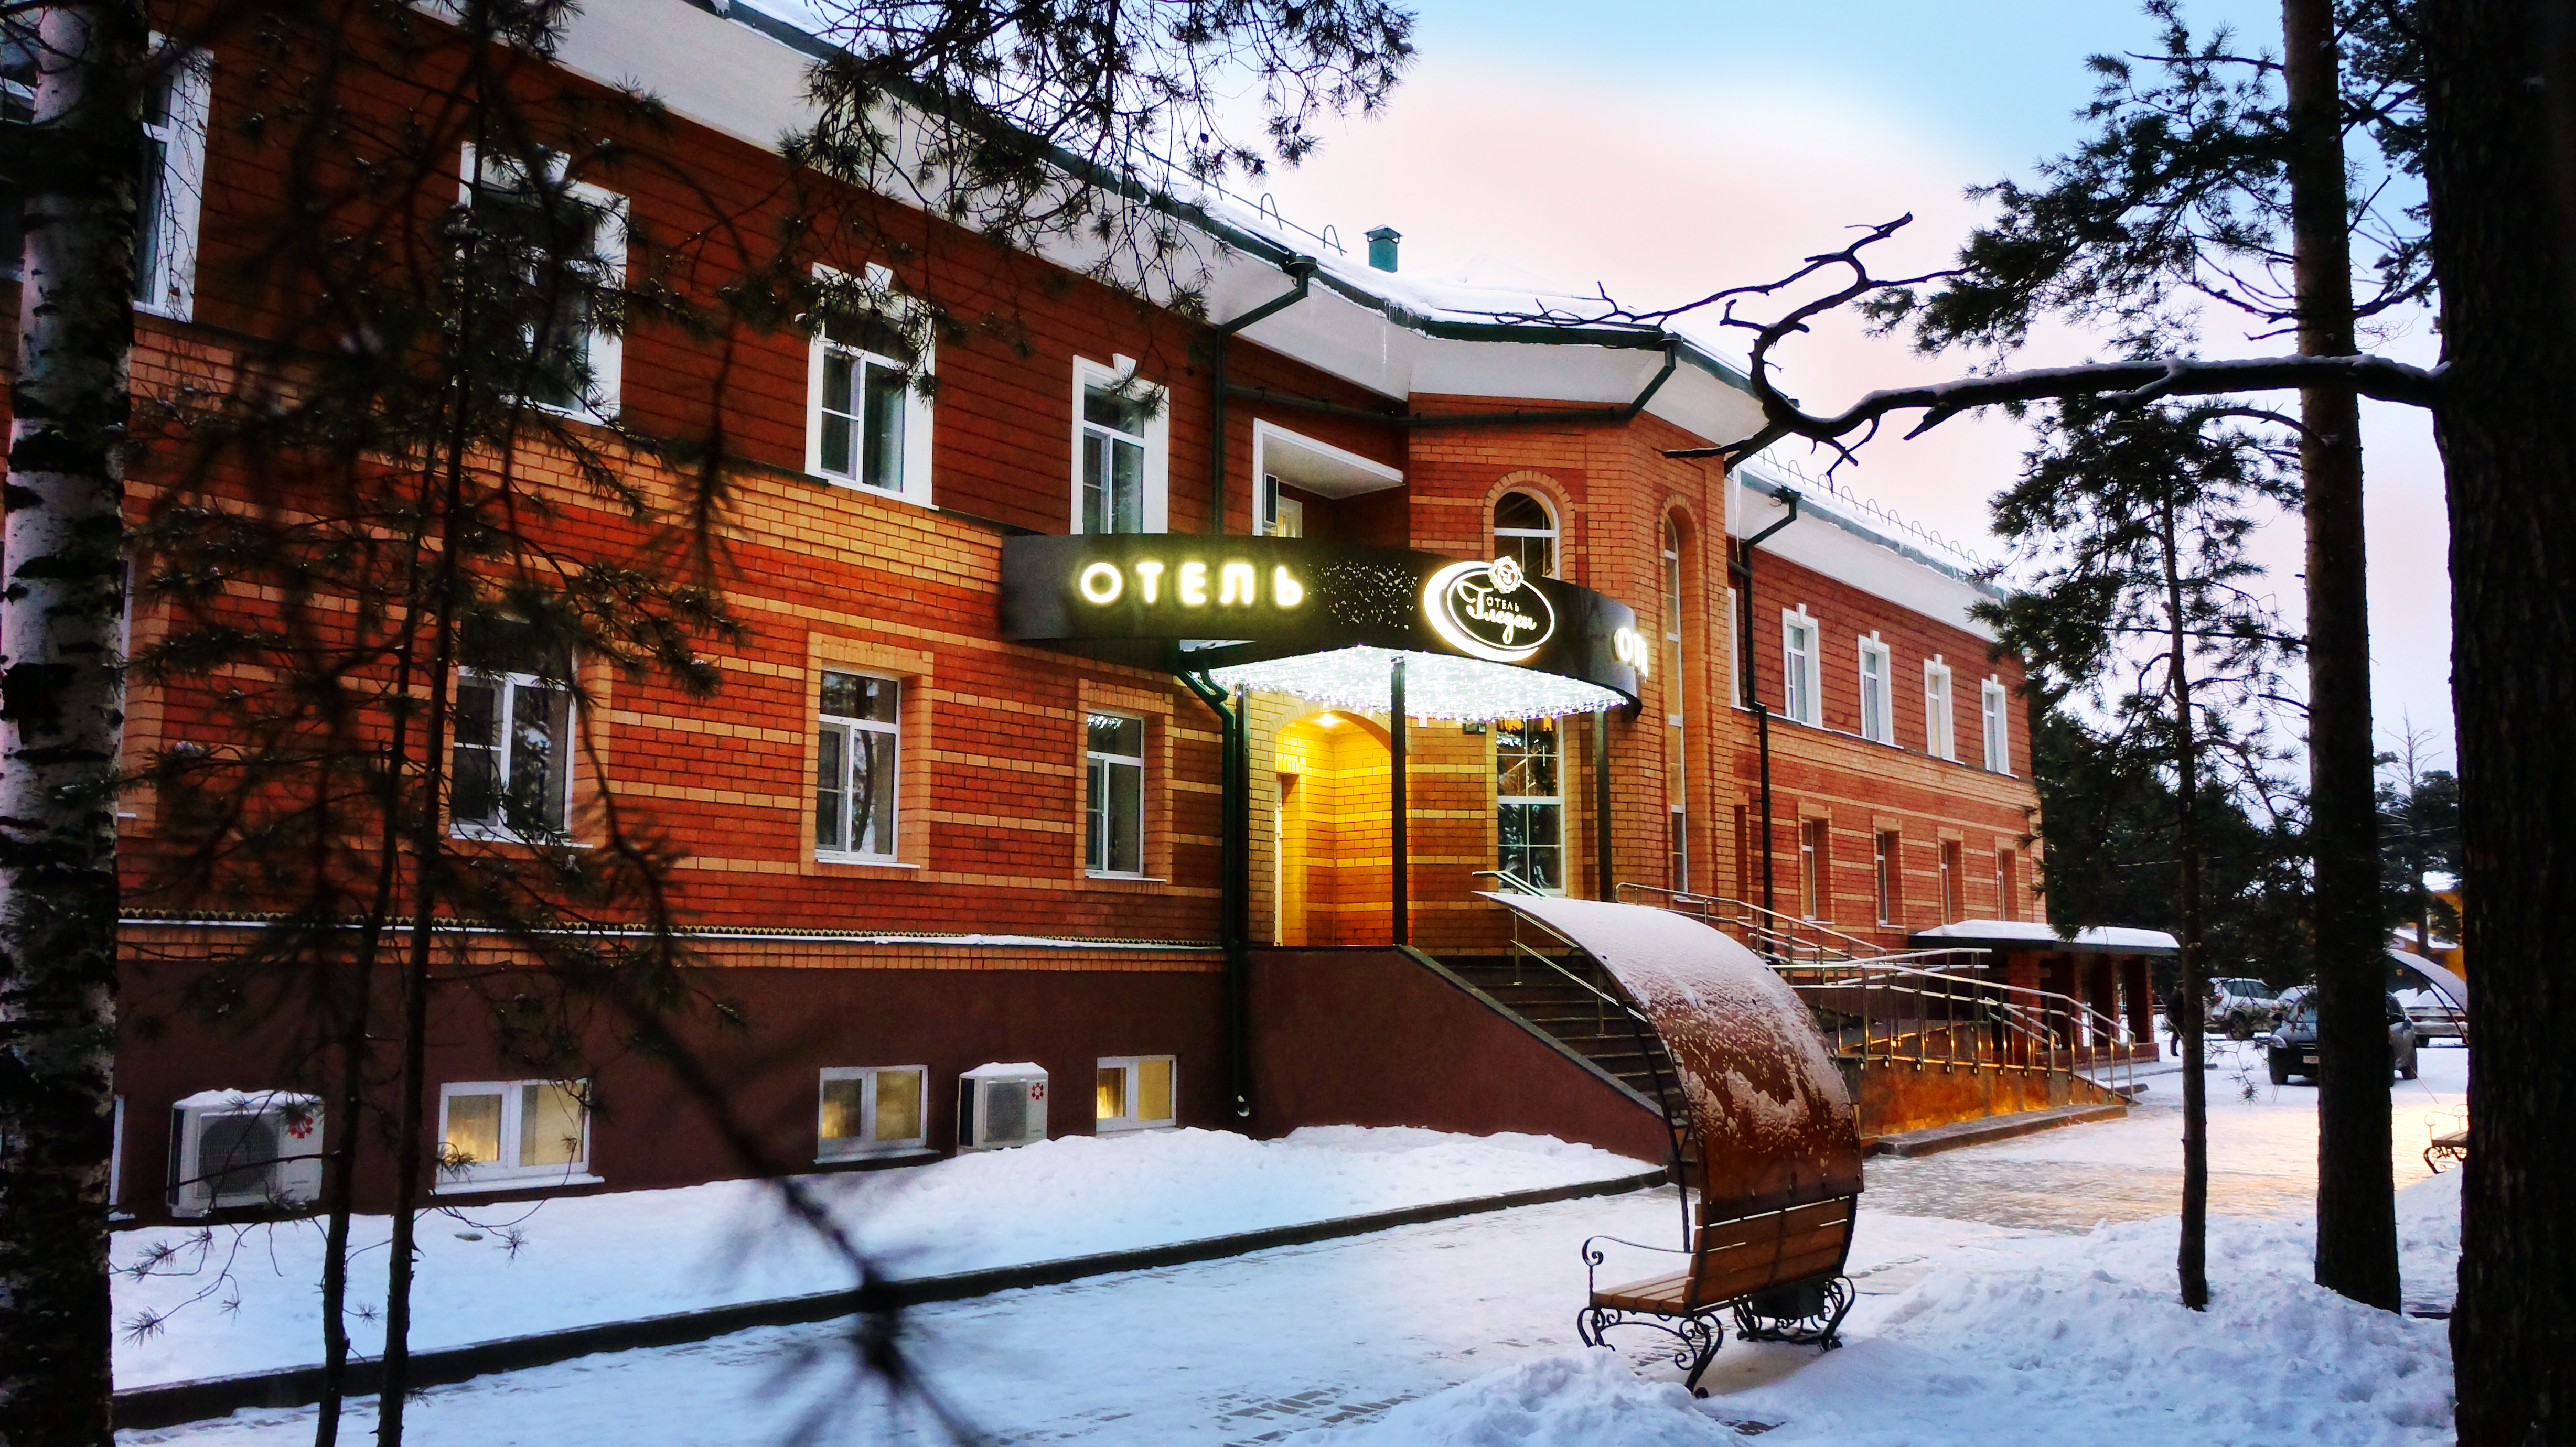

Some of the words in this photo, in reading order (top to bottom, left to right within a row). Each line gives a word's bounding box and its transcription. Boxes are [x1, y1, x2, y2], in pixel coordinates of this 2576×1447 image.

[1080, 560, 1303, 607] ОТЕЛЬ
[1486, 596, 1520, 612] ОТЕЛЬ
[1457, 581, 1537, 644] Гледен
